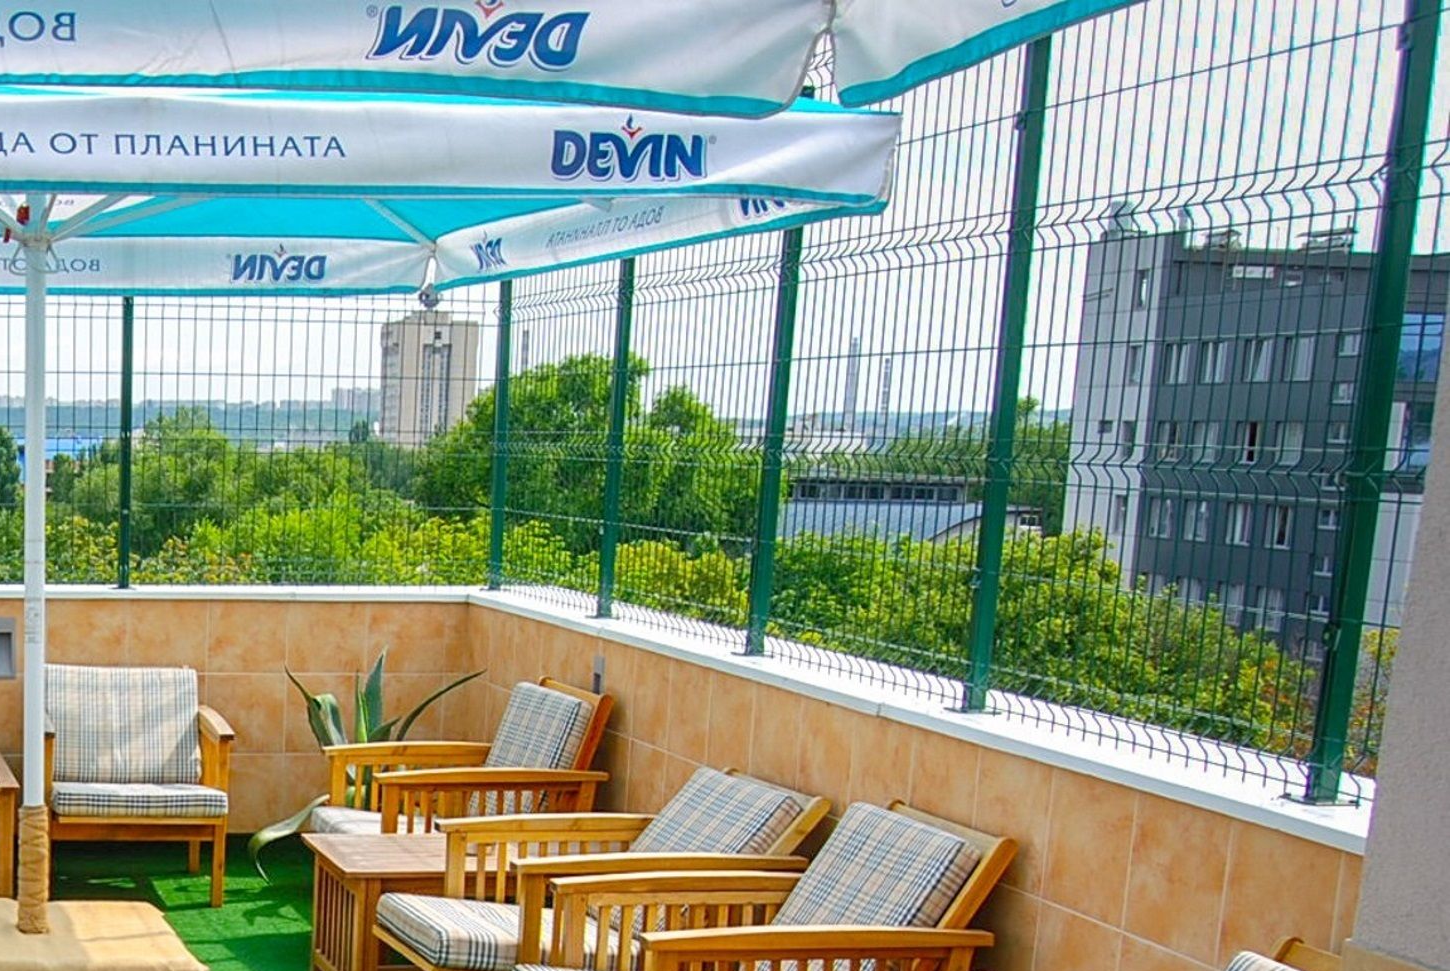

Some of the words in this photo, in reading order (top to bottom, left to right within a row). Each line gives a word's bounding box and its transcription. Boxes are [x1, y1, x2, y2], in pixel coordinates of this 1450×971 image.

[49, 132, 99, 155] ОТ
[114, 133, 347, 158] ПЛАНИНАТА
[550, 129, 706, 182] DEVIN
